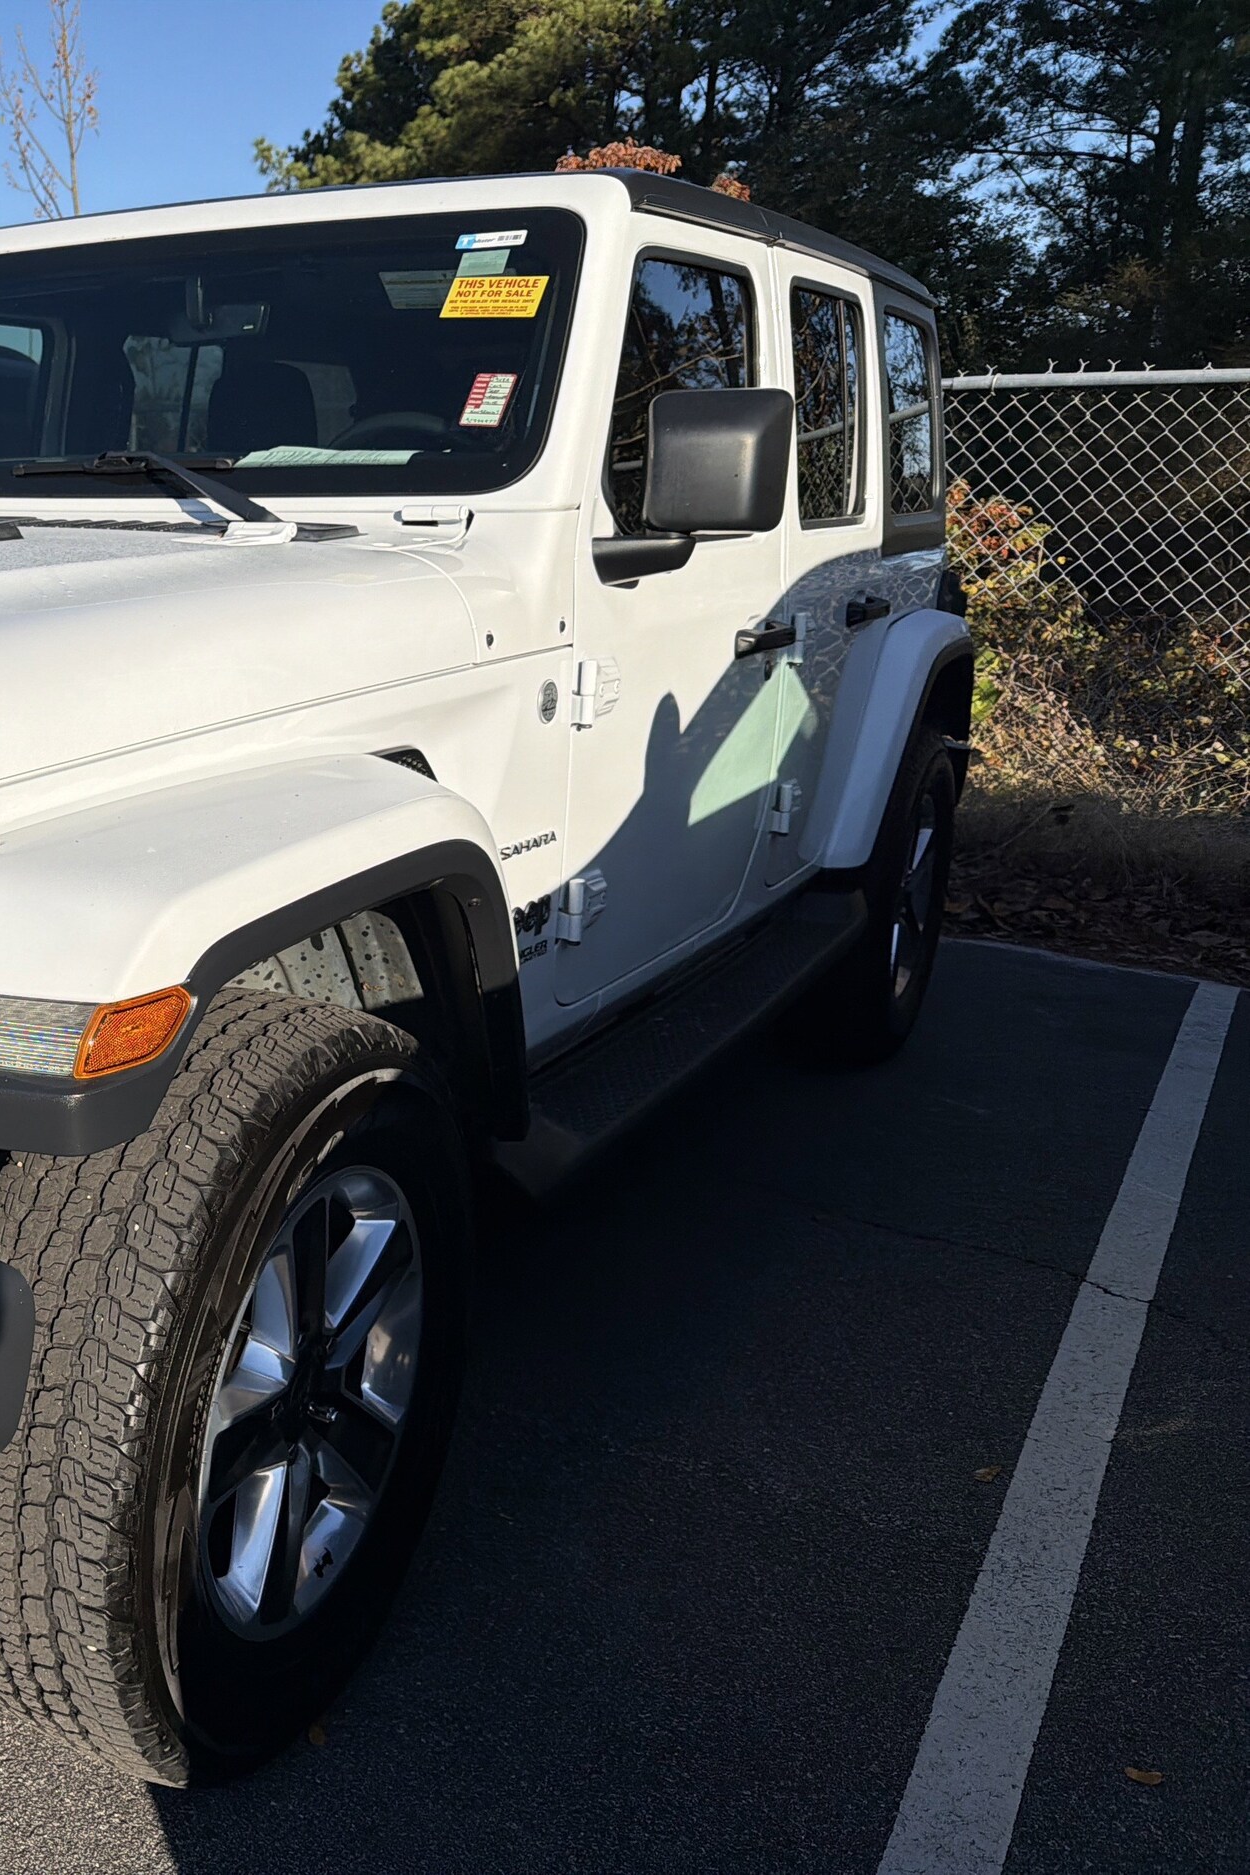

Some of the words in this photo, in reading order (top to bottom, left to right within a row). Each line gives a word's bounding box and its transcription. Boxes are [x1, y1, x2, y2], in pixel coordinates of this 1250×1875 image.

[455, 290, 478, 298] NOT
[480, 290, 504, 298] FOR
[505, 289, 534, 298] SALE
[458, 279, 485, 289] THIS
[489, 278, 541, 289] VEHICLE
[500, 831, 557, 861] SAHARA
[511, 894, 551, 936] eep
[520, 939, 548, 959] NGLER
